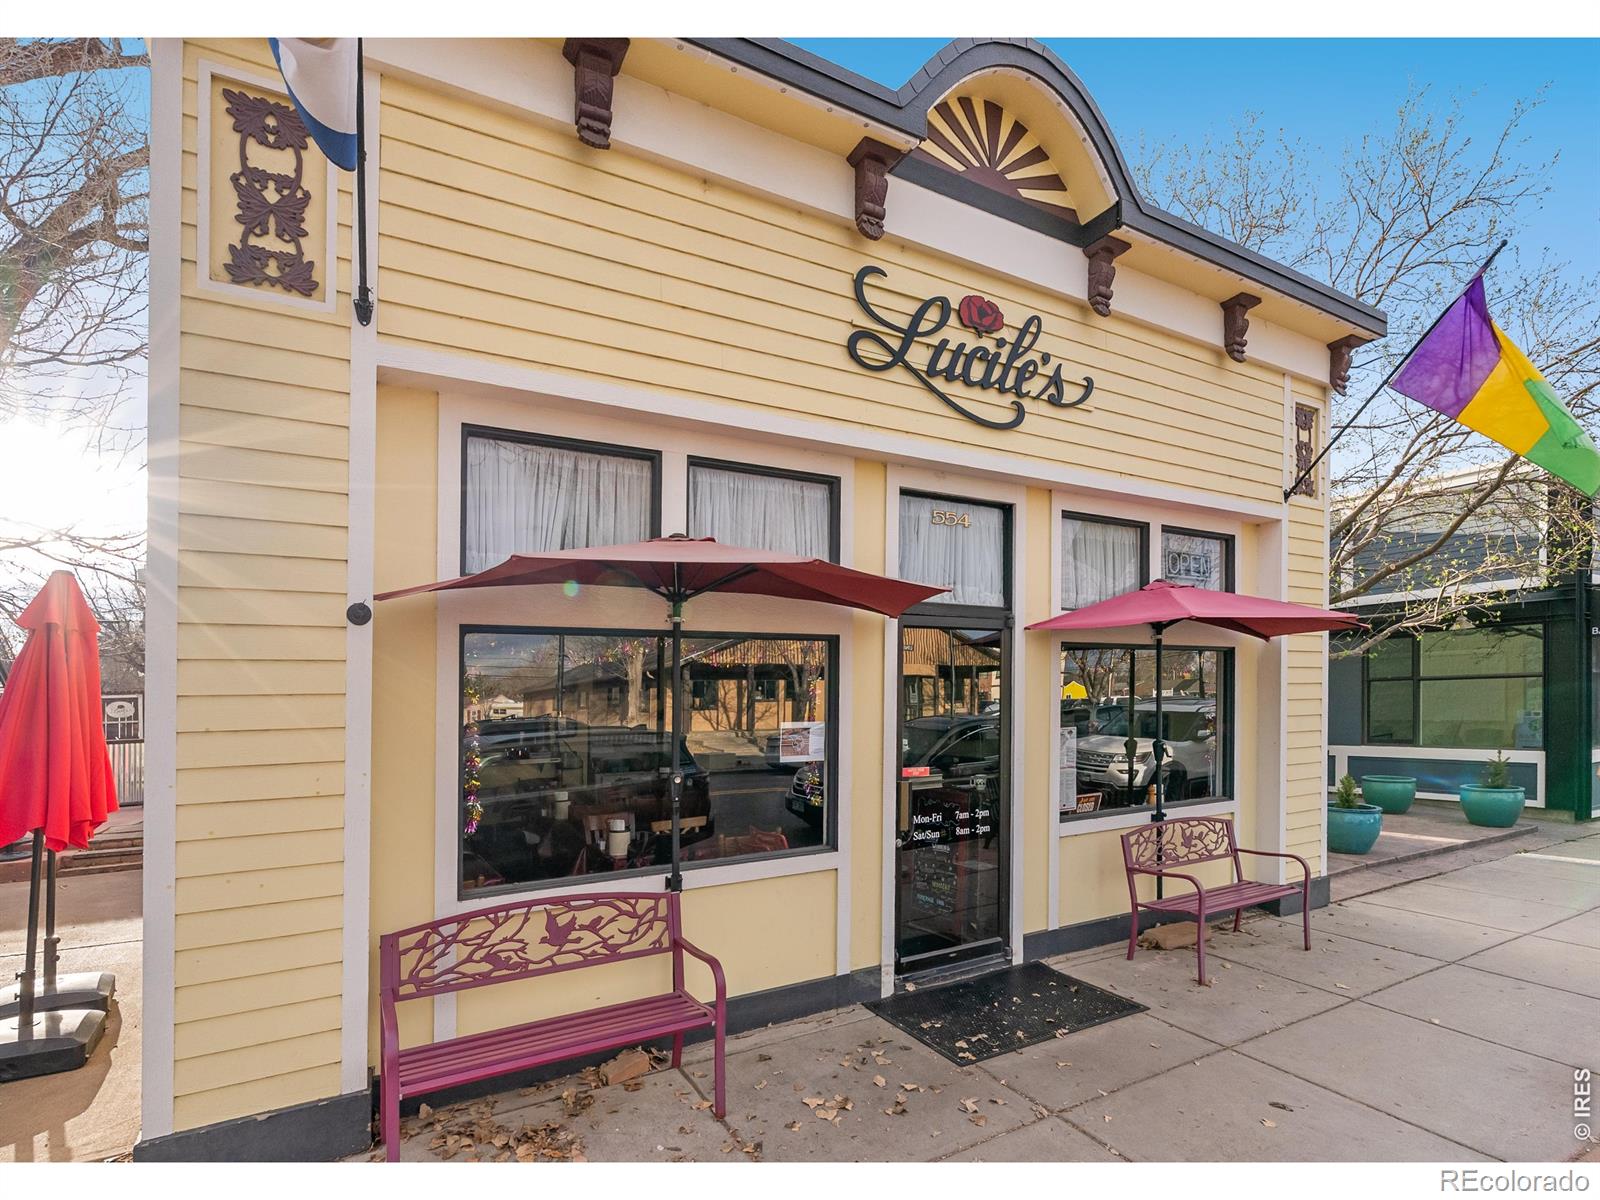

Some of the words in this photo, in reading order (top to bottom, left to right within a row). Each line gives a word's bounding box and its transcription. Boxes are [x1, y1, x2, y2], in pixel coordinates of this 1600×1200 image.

[848, 265, 1095, 430] Lucile's
[931, 510, 971, 528] 554
[1168, 552, 1210, 577] OPEN
[913, 812, 942, 824] Mon-Fri
[955, 811, 969, 819] 7am
[975, 809, 990, 819] 2pm
[913, 830, 940, 840] Sat/Sun
[956, 826, 970, 836] 8am
[976, 824, 990, 834] 2pm
